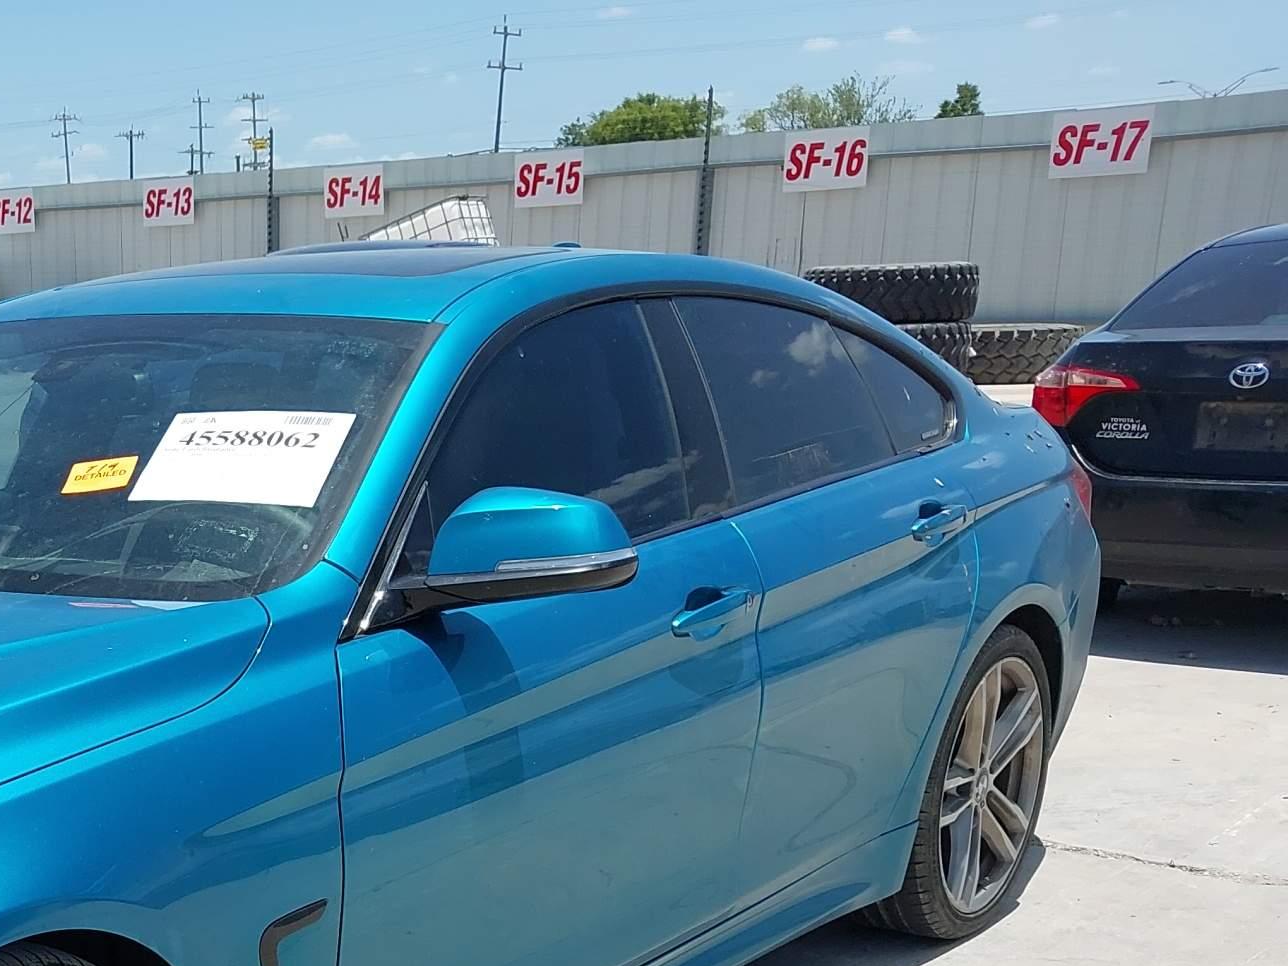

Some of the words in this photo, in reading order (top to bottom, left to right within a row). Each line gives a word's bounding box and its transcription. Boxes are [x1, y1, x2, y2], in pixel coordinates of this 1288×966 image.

[785, 138, 866, 181] SF-16
[1052, 119, 1150, 167] SF-17
[326, 174, 381, 209] SF-14
[515, 159, 581, 198] SF-15
[143, 186, 193, 220] SF-13
[179, 430, 320, 448] 45588062
[1096, 430, 1150, 440] COROLLA
[1102, 422, 1147, 431] VICTORIA
[74, 469, 127, 481] DETAILED
